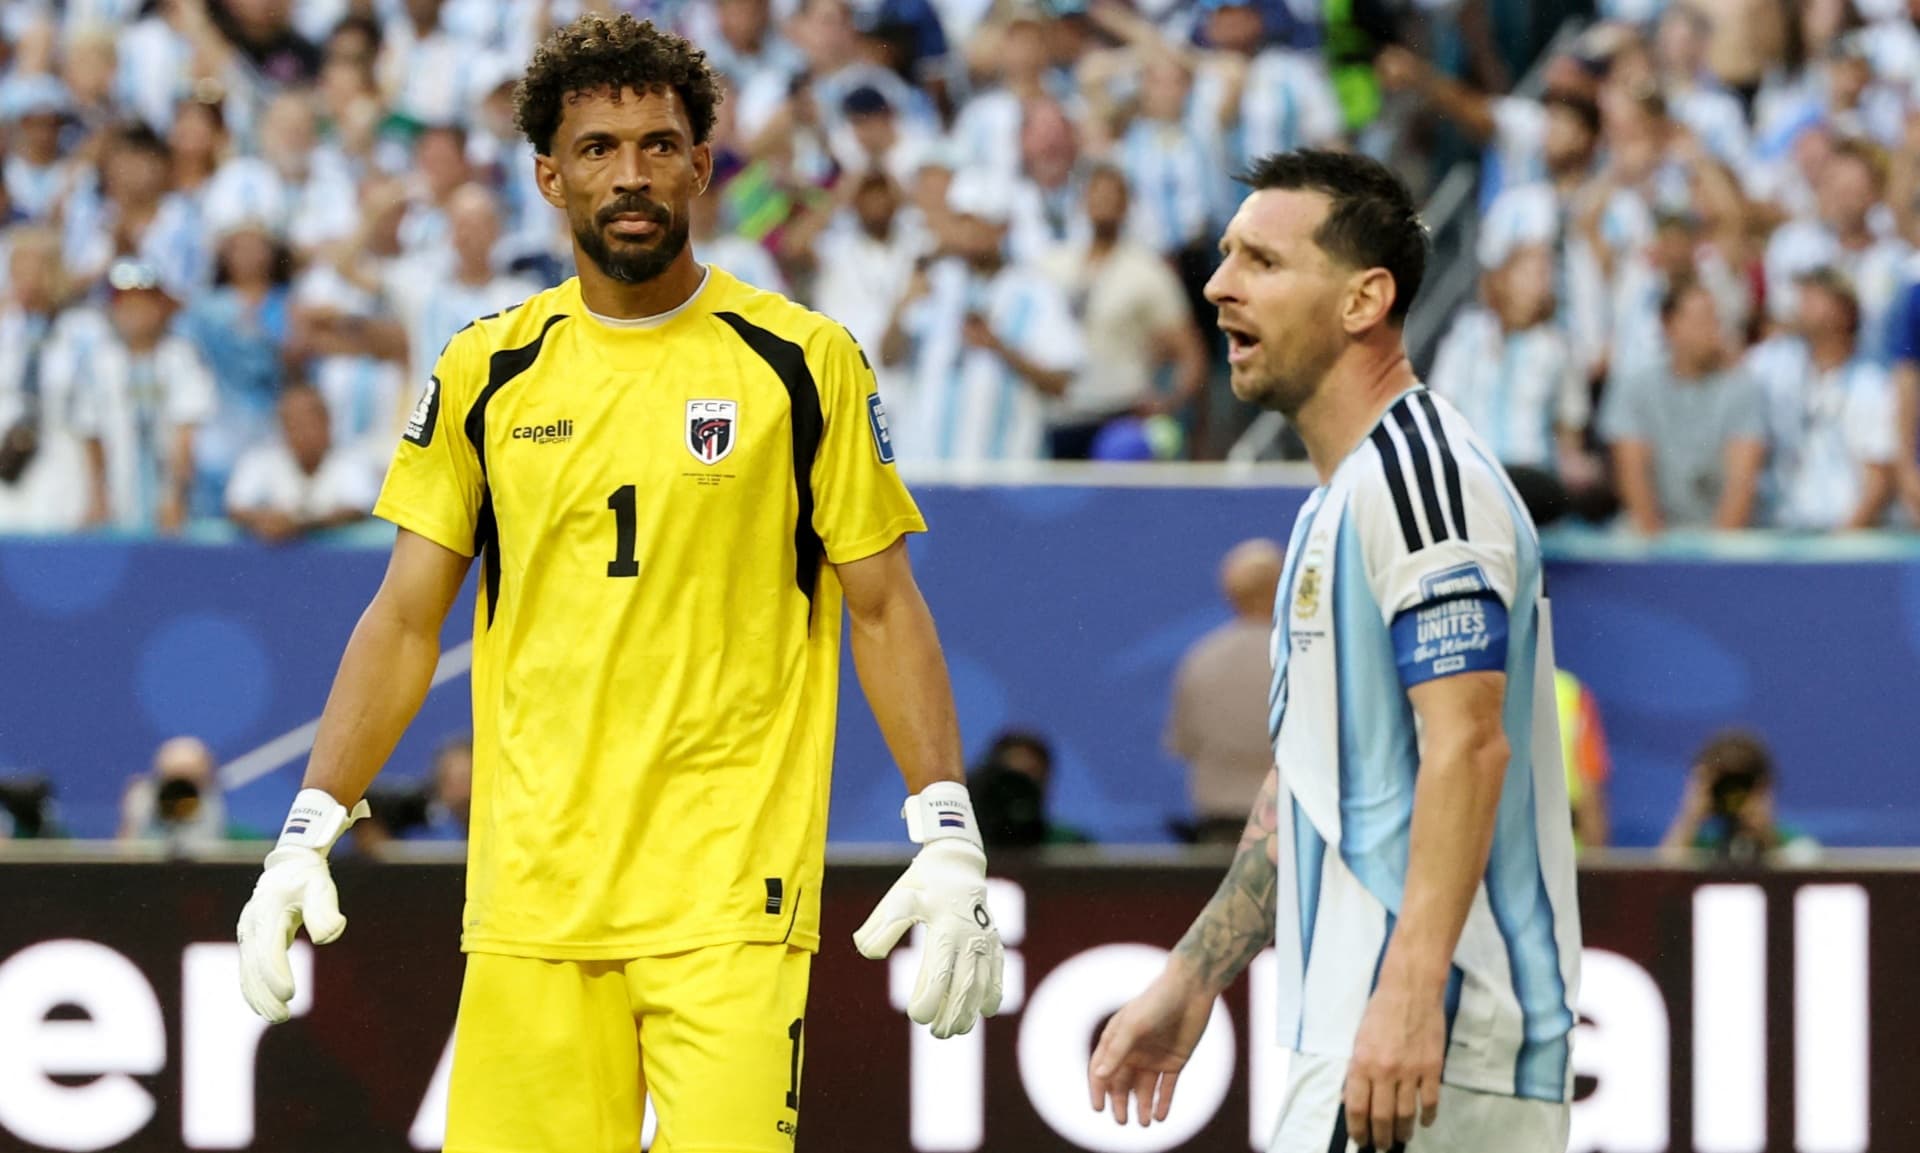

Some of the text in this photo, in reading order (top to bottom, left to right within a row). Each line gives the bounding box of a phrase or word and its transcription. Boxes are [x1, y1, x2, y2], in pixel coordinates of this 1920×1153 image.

[690, 402, 732, 413] FCF
[512, 419, 573, 443] capelli
[606, 485, 639, 577] 1
[1417, 613, 1486, 644] UNITES
[1413, 644, 1438, 664] the
